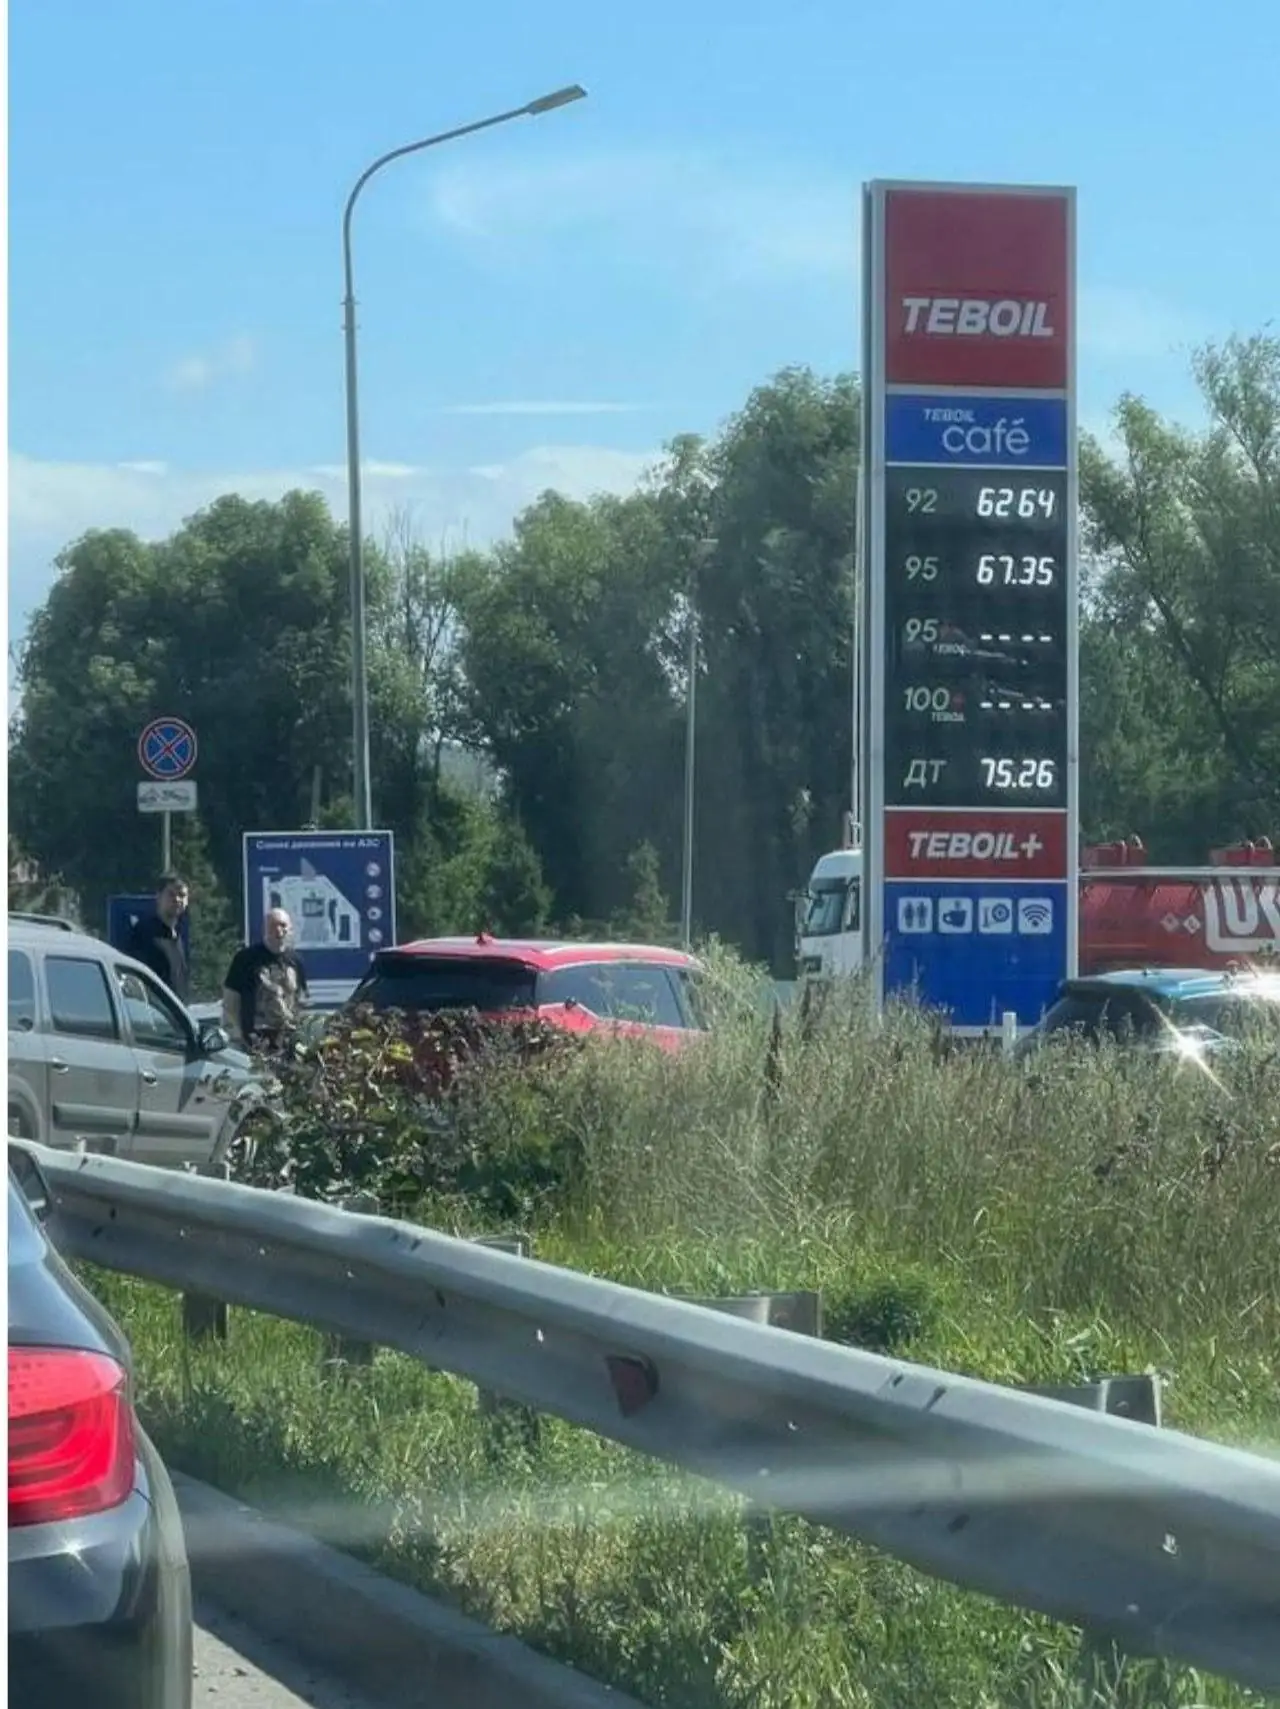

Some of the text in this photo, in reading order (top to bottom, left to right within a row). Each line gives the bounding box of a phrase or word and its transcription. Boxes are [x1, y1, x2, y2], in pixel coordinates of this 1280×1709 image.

[902, 297, 1055, 337] TEBOIL
[942, 418, 1031, 455] café
[905, 488, 938, 514] 92
[905, 556, 1055, 585] 95 67.35
[905, 618, 939, 643] 95
[904, 687, 950, 711] 100
[903, 758, 1055, 788] ДТ 75.26
[908, 831, 1043, 860] TEBOIL+
